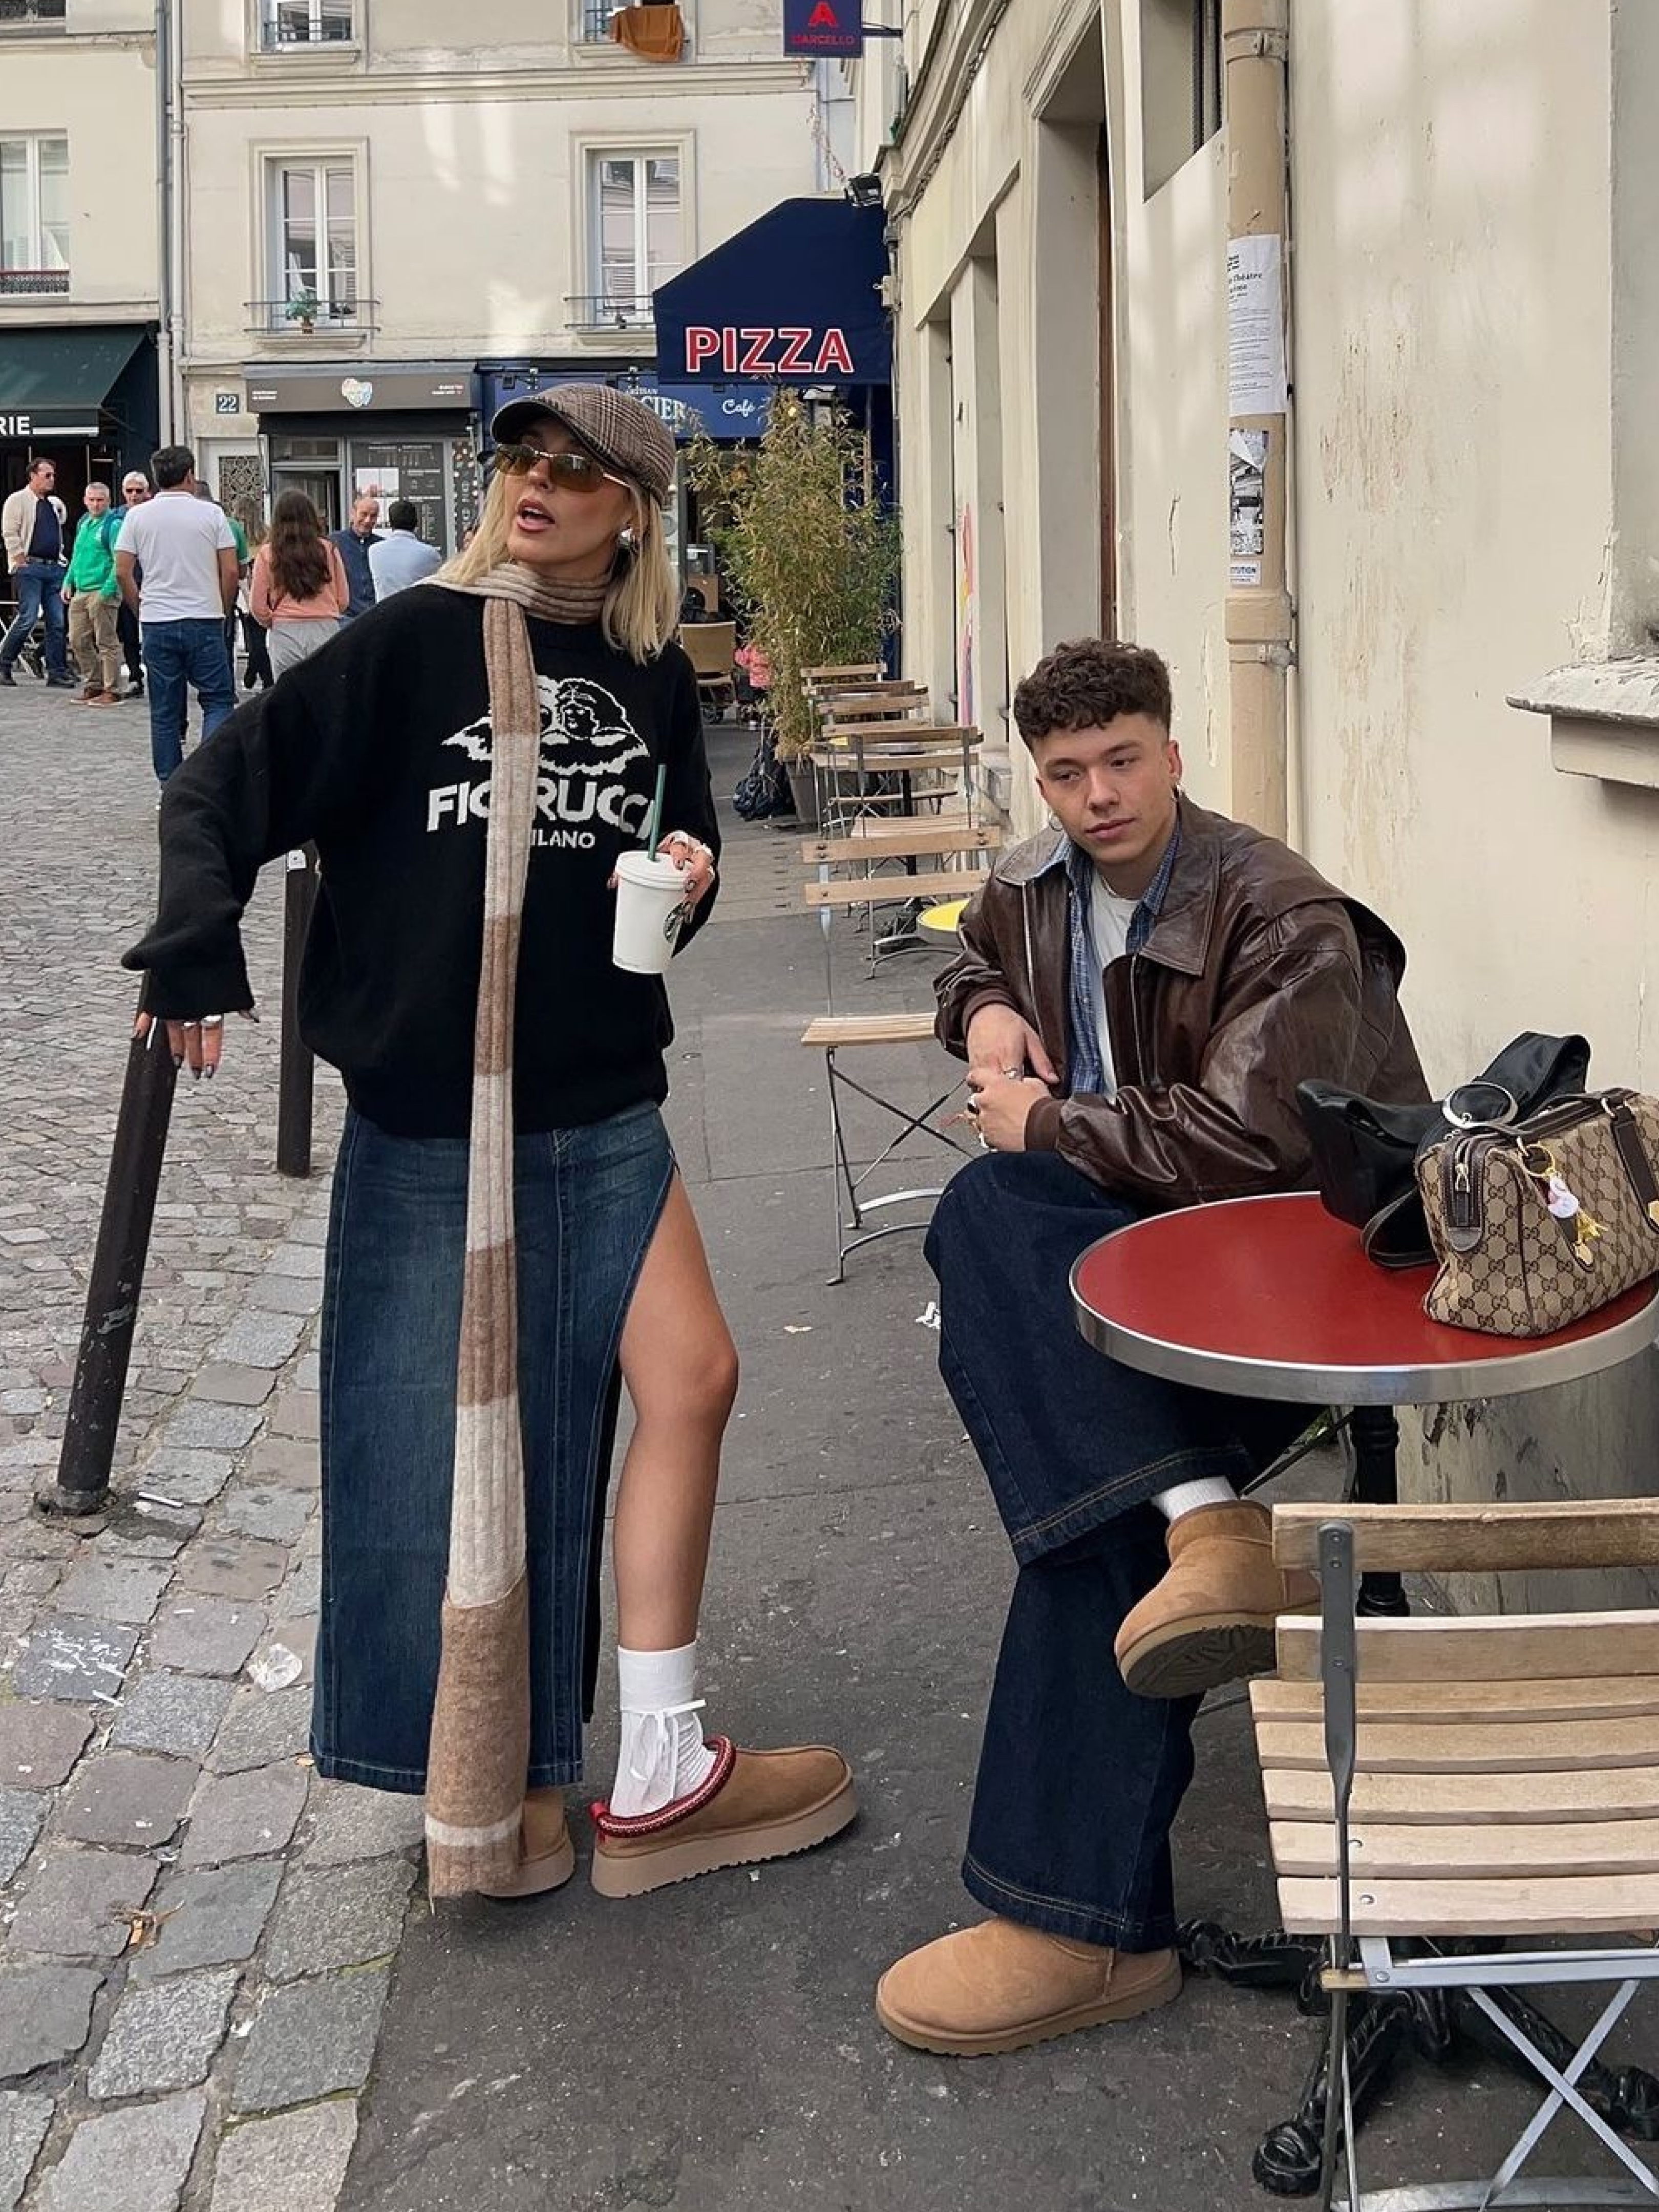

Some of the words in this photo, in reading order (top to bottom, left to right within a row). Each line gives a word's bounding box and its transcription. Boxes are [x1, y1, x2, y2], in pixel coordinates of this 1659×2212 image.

[685, 327, 855, 373] PIZZA
[219, 395, 236, 411] 22
[640, 395, 687, 419] CIER
[531, 828, 596, 849] ILANO
